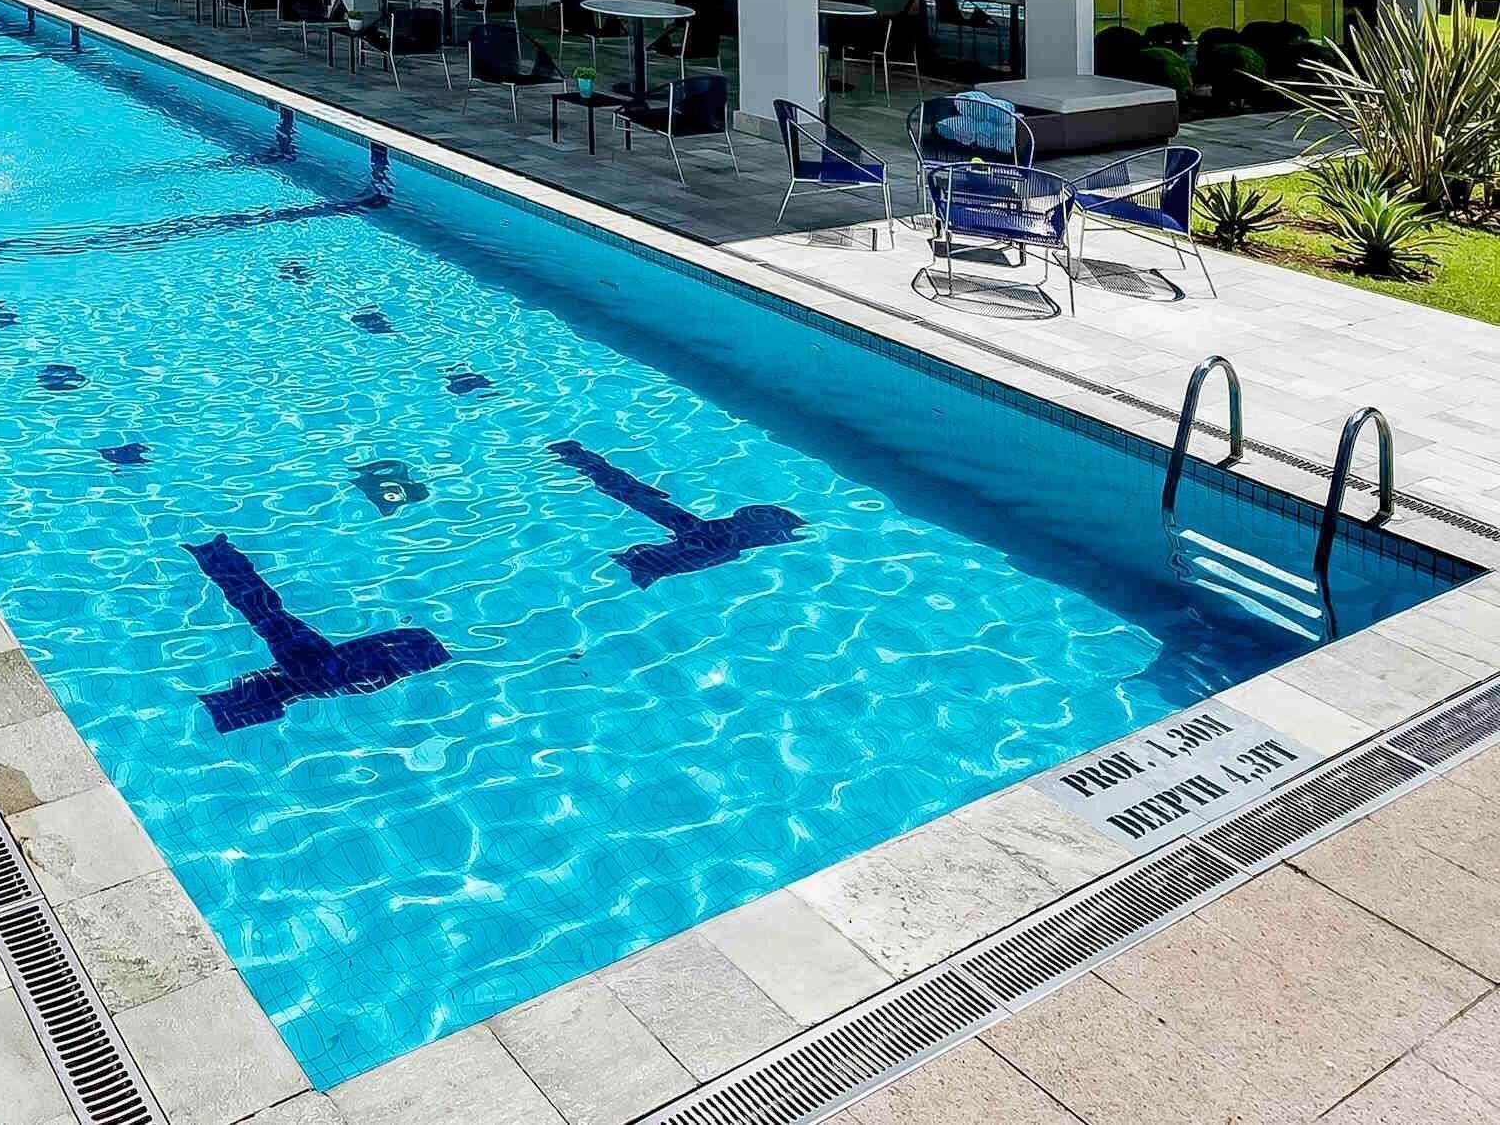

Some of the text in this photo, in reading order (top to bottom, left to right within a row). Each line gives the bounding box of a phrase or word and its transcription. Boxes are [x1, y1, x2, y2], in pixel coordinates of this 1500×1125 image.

[1059, 714, 1235, 798] PROF. 1,30M
[1106, 739, 1300, 840] DEEPTH 4,3FT
